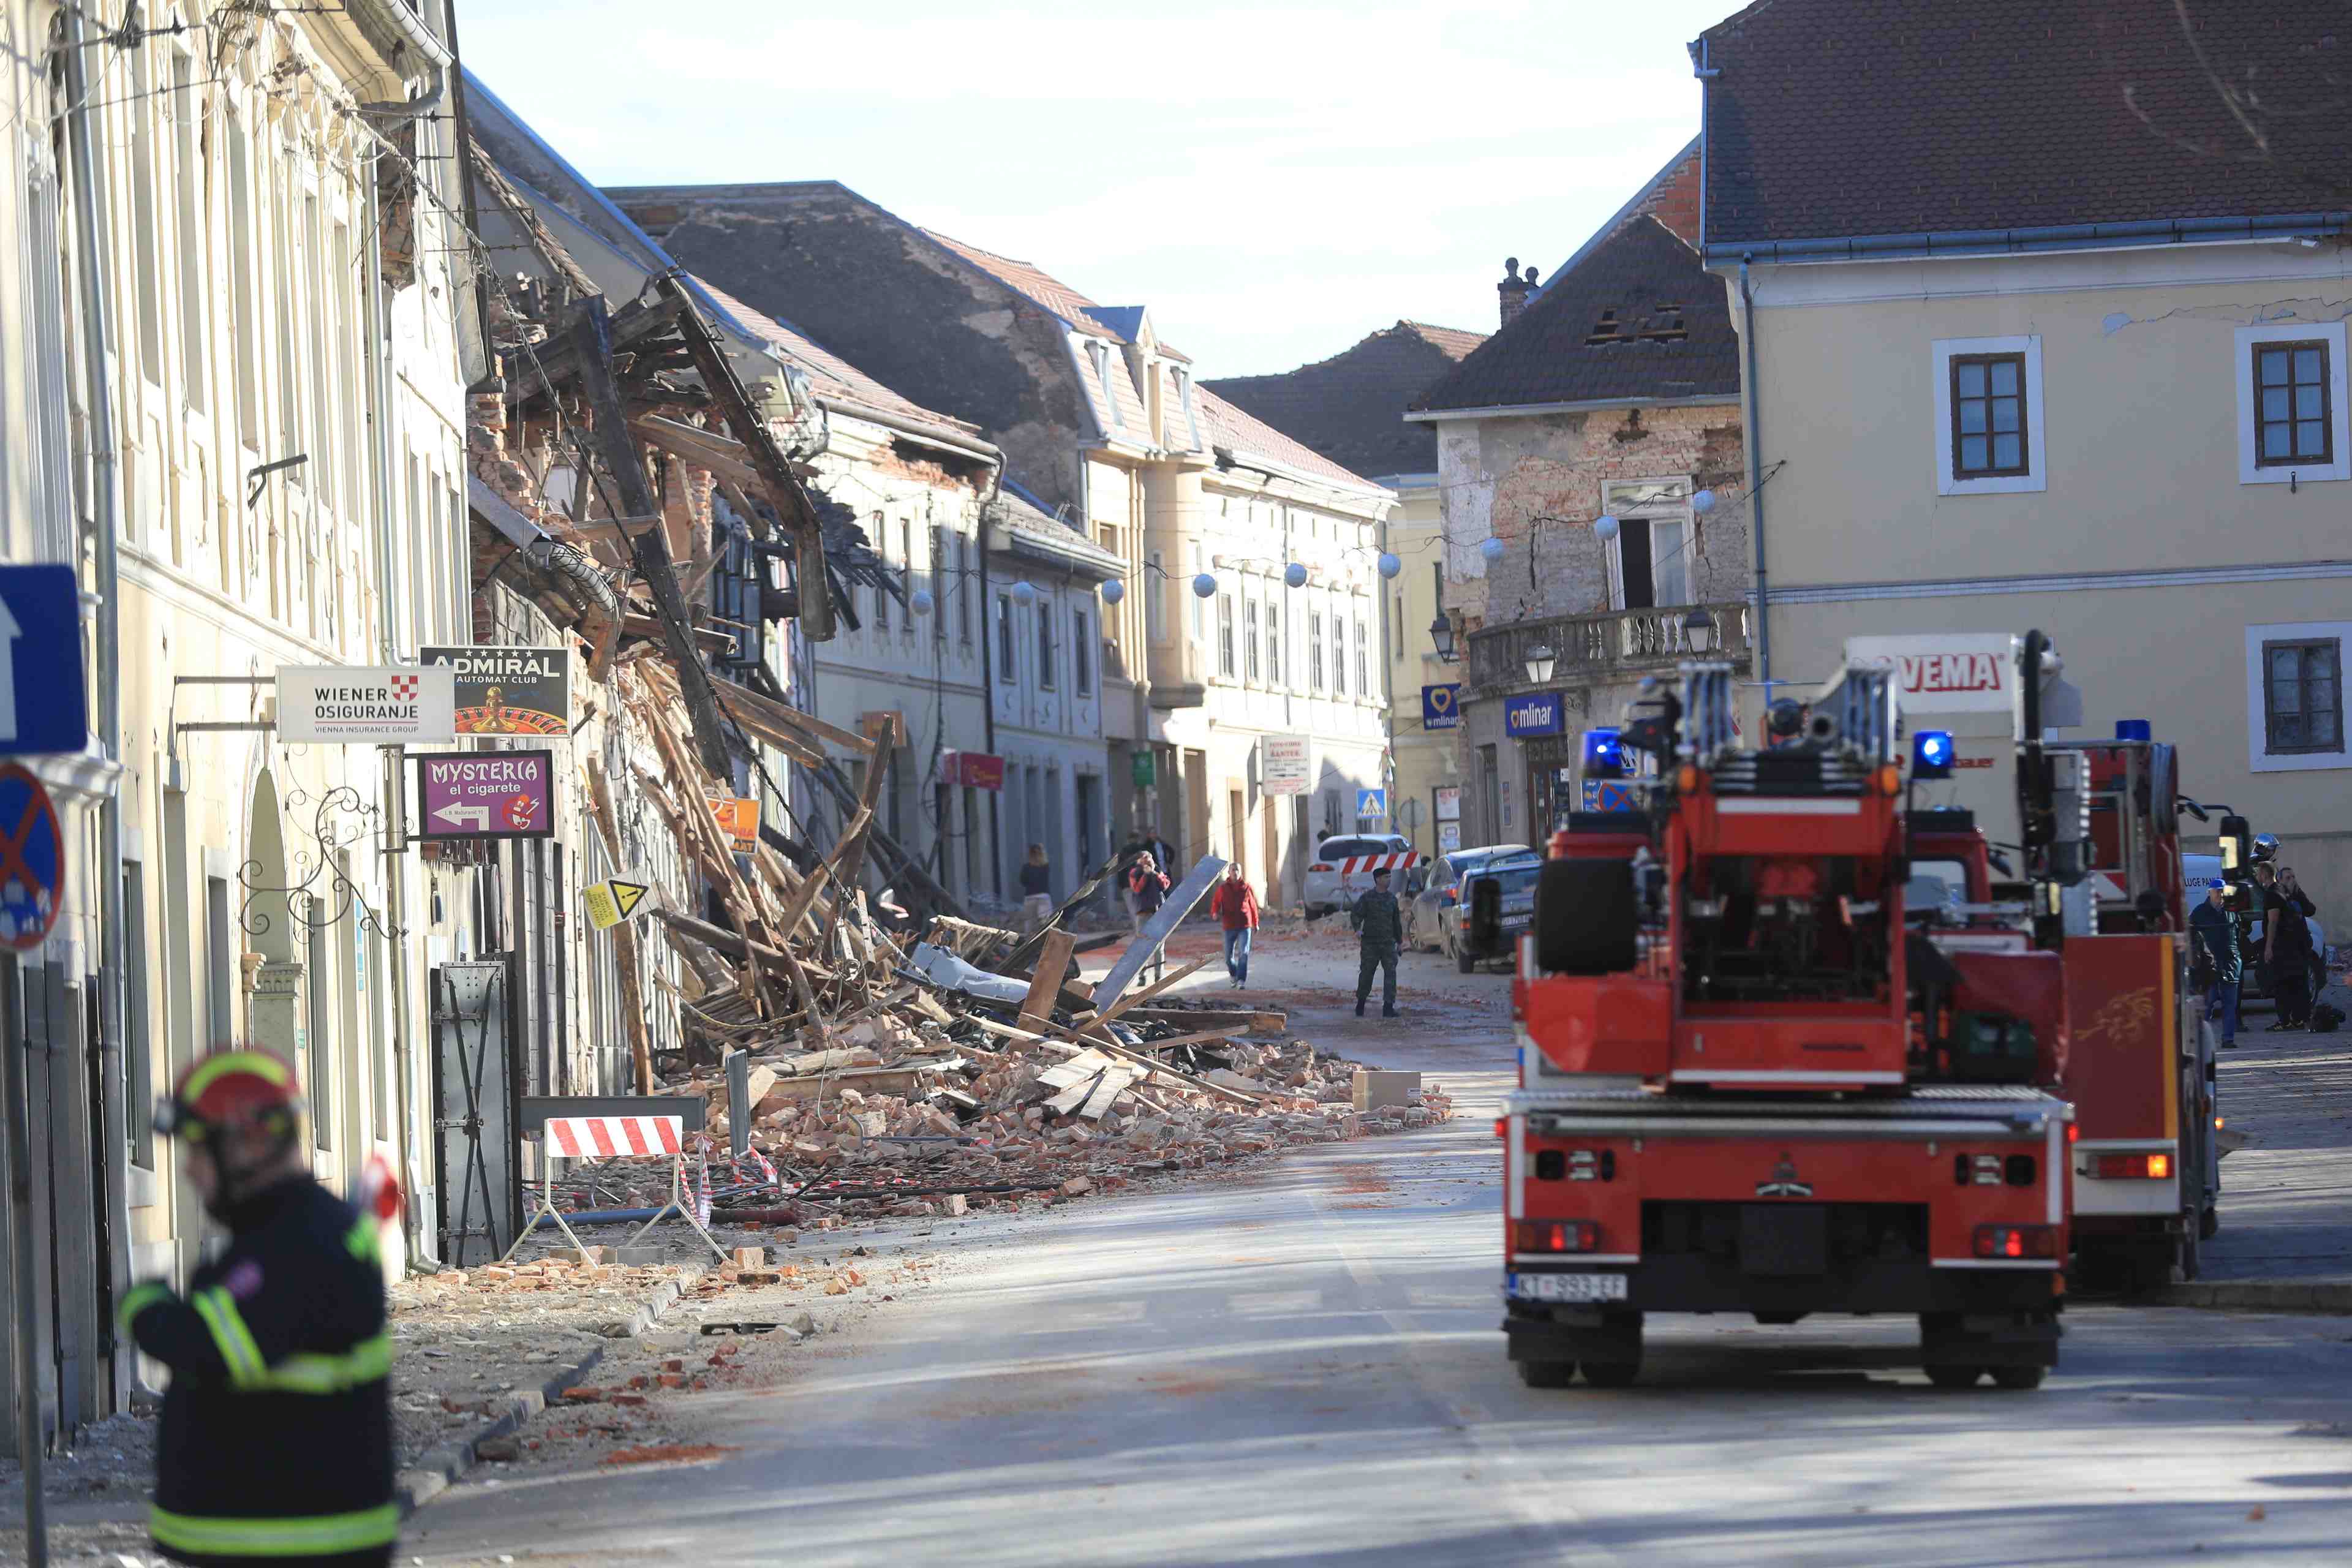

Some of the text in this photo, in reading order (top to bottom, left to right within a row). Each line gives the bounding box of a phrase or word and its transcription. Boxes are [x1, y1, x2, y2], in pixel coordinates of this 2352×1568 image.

[1852, 653, 2001, 693] VEMA
[315, 688, 387, 701] WIENER
[315, 705, 418, 718] OSIGURANJE
[1520, 703, 1552, 728] mlinar
[431, 760, 538, 783] MYSTERIA
[450, 783, 521, 796] el cigarete
